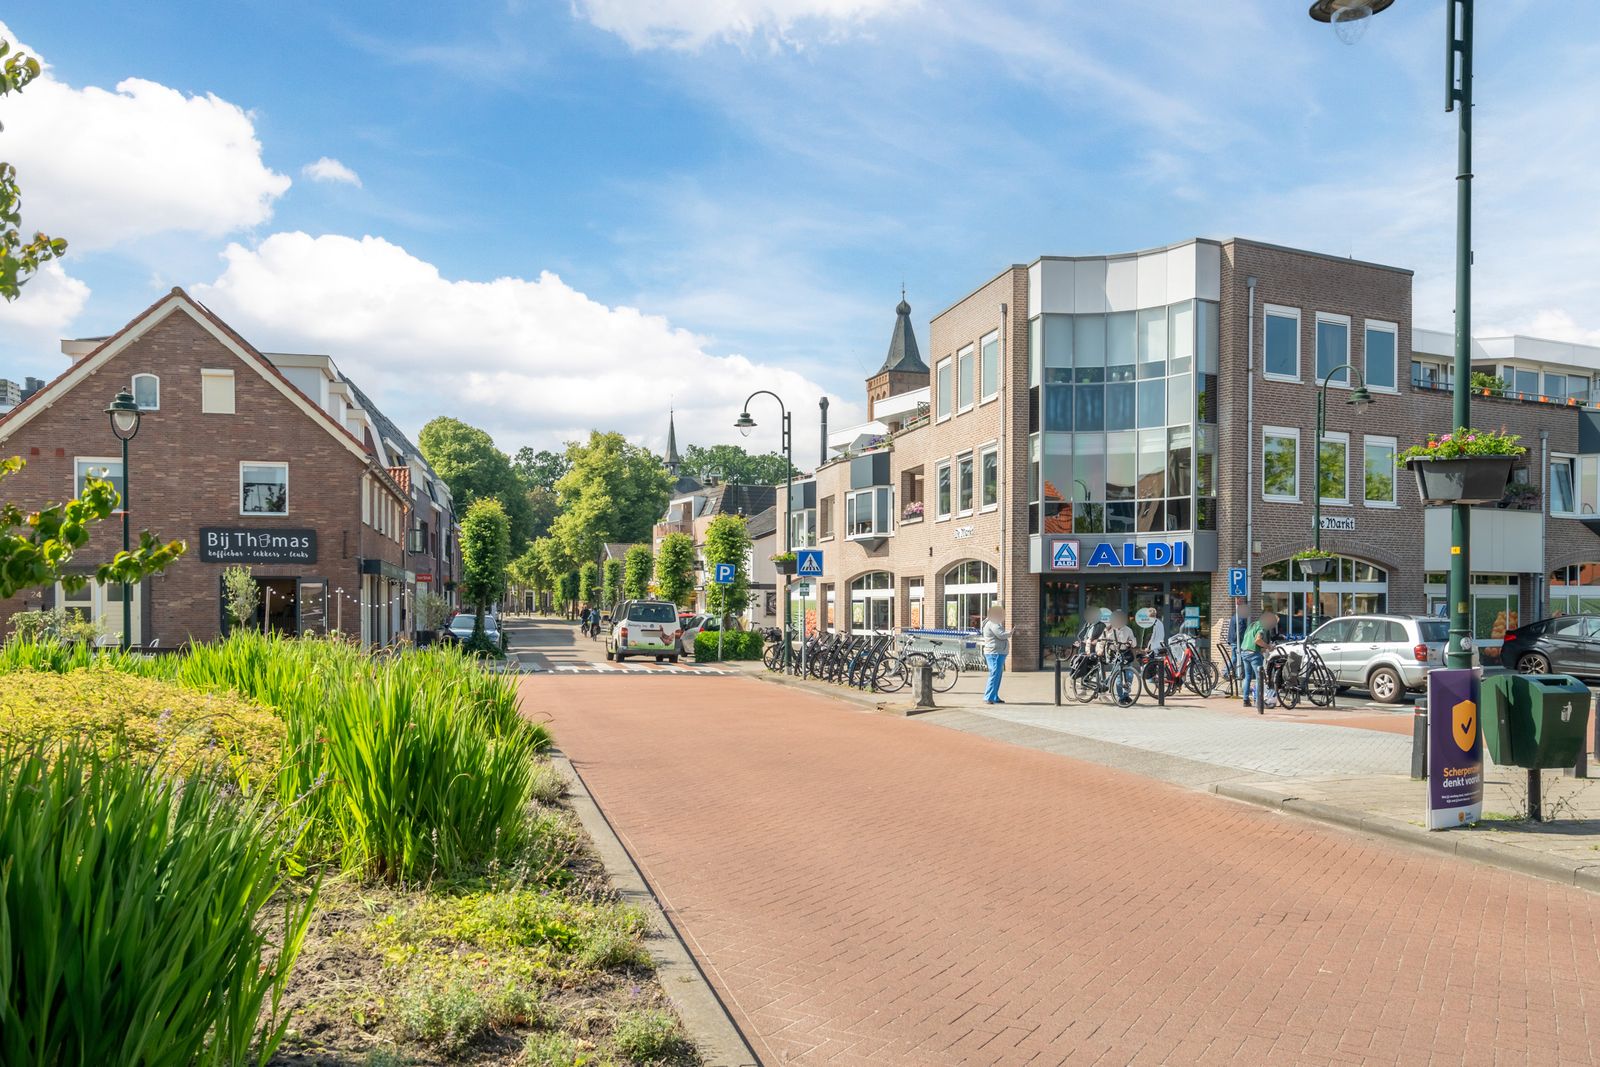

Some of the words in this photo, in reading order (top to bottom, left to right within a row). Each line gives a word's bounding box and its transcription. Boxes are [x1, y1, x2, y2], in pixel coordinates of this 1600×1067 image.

[1325, 517, 1354, 529] Markt
[207, 532, 229, 550] Bij
[208, 549, 244, 559] koffiebar
[252, 550, 280, 558] lekkers
[289, 551, 309, 559] leuks
[1087, 541, 1184, 567] ALDI
[720, 566, 731, 581] P
[1233, 570, 1243, 585] P
[31, 591, 42, 599] 24
[1442, 777, 1465, 788] denkt
